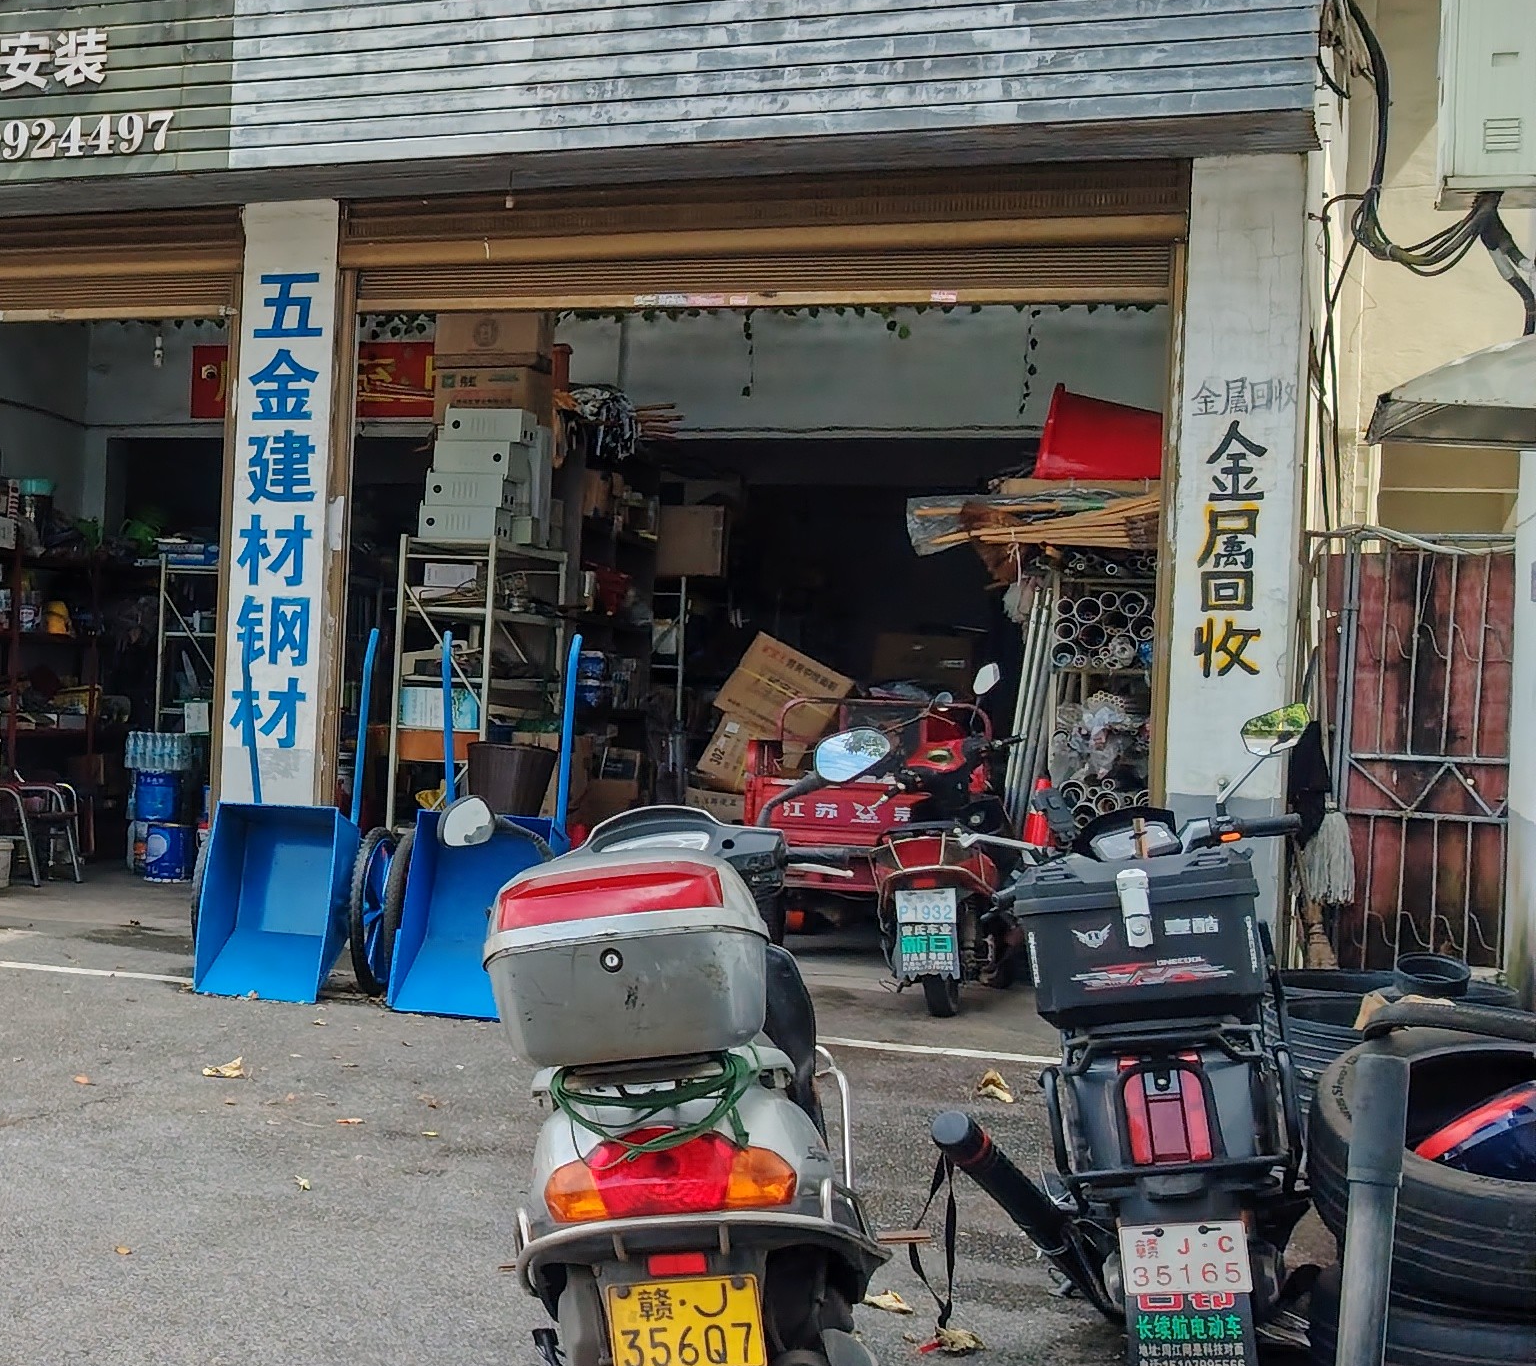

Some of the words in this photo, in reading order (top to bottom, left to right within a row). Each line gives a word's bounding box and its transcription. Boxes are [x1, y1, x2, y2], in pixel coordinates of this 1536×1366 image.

[1191, 376, 1297, 417] 金属回收
[228, 271, 324, 750] 五金建材钢材
[1193, 420, 1268, 678] 金属回收
[782, 801, 839, 819] 江苏
[898, 903, 953, 921] P1932
[901, 935, 953, 954] 新日
[1133, 1261, 1242, 1288] 35165
[638, 1282, 729, 1323] 赣·J
[1135, 1314, 1244, 1340] 长续航电动车
